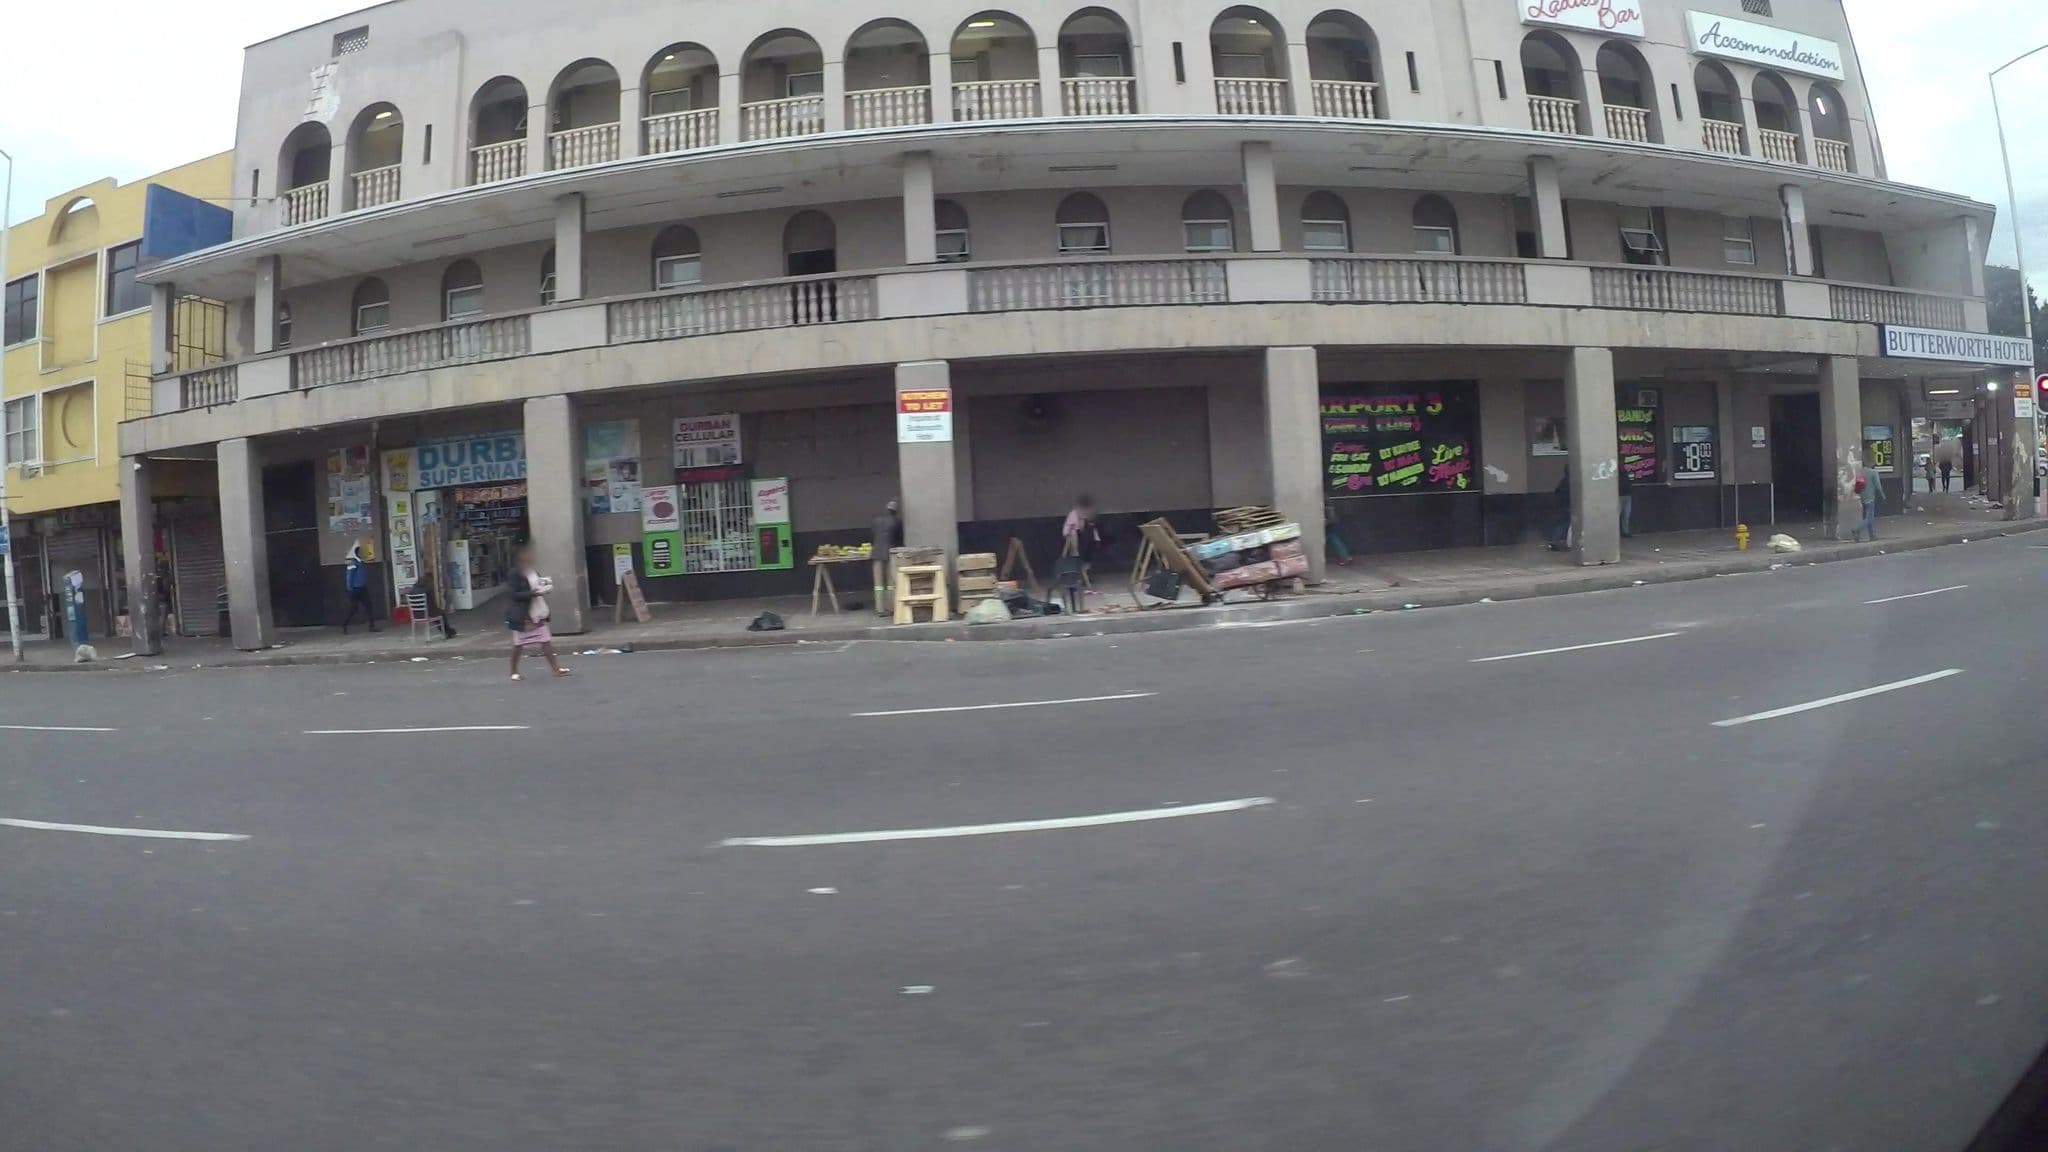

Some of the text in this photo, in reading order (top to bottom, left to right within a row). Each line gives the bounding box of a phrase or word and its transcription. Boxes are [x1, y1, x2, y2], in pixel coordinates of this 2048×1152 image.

[1598, 0, 1639, 29] Bar
[1700, 21, 1839, 71] Accommodation
[1888, 330, 2032, 362] BUTTERWORTH HOTEL
[675, 430, 735, 442] CELLULAR
[680, 419, 732, 432] DURBAN
[418, 436, 526, 470] DURB
[1431, 443, 1464, 465] Live
